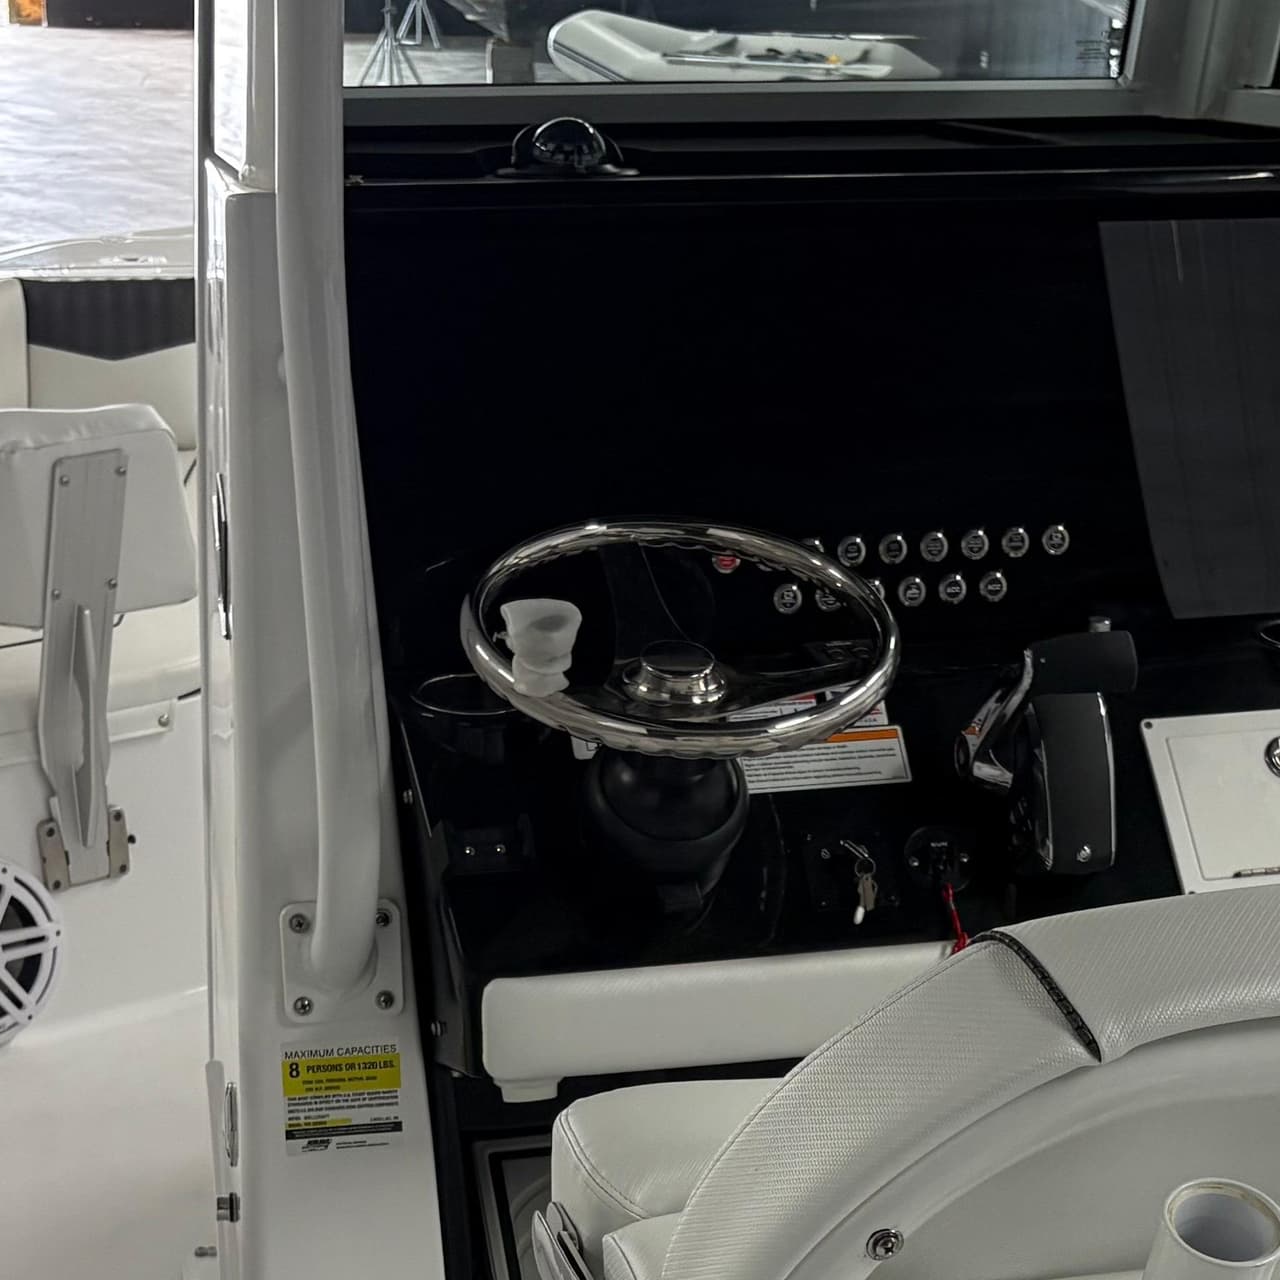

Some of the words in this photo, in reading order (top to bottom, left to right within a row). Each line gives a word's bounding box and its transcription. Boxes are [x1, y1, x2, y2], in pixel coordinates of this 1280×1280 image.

[284, 1048, 334, 1060] MAXIMUM
[336, 1044, 397, 1056] CAPACITIES
[289, 1062, 300, 1078] 8
[307, 1063, 343, 1074] PERSONS
[345, 1062, 356, 1071] OR
